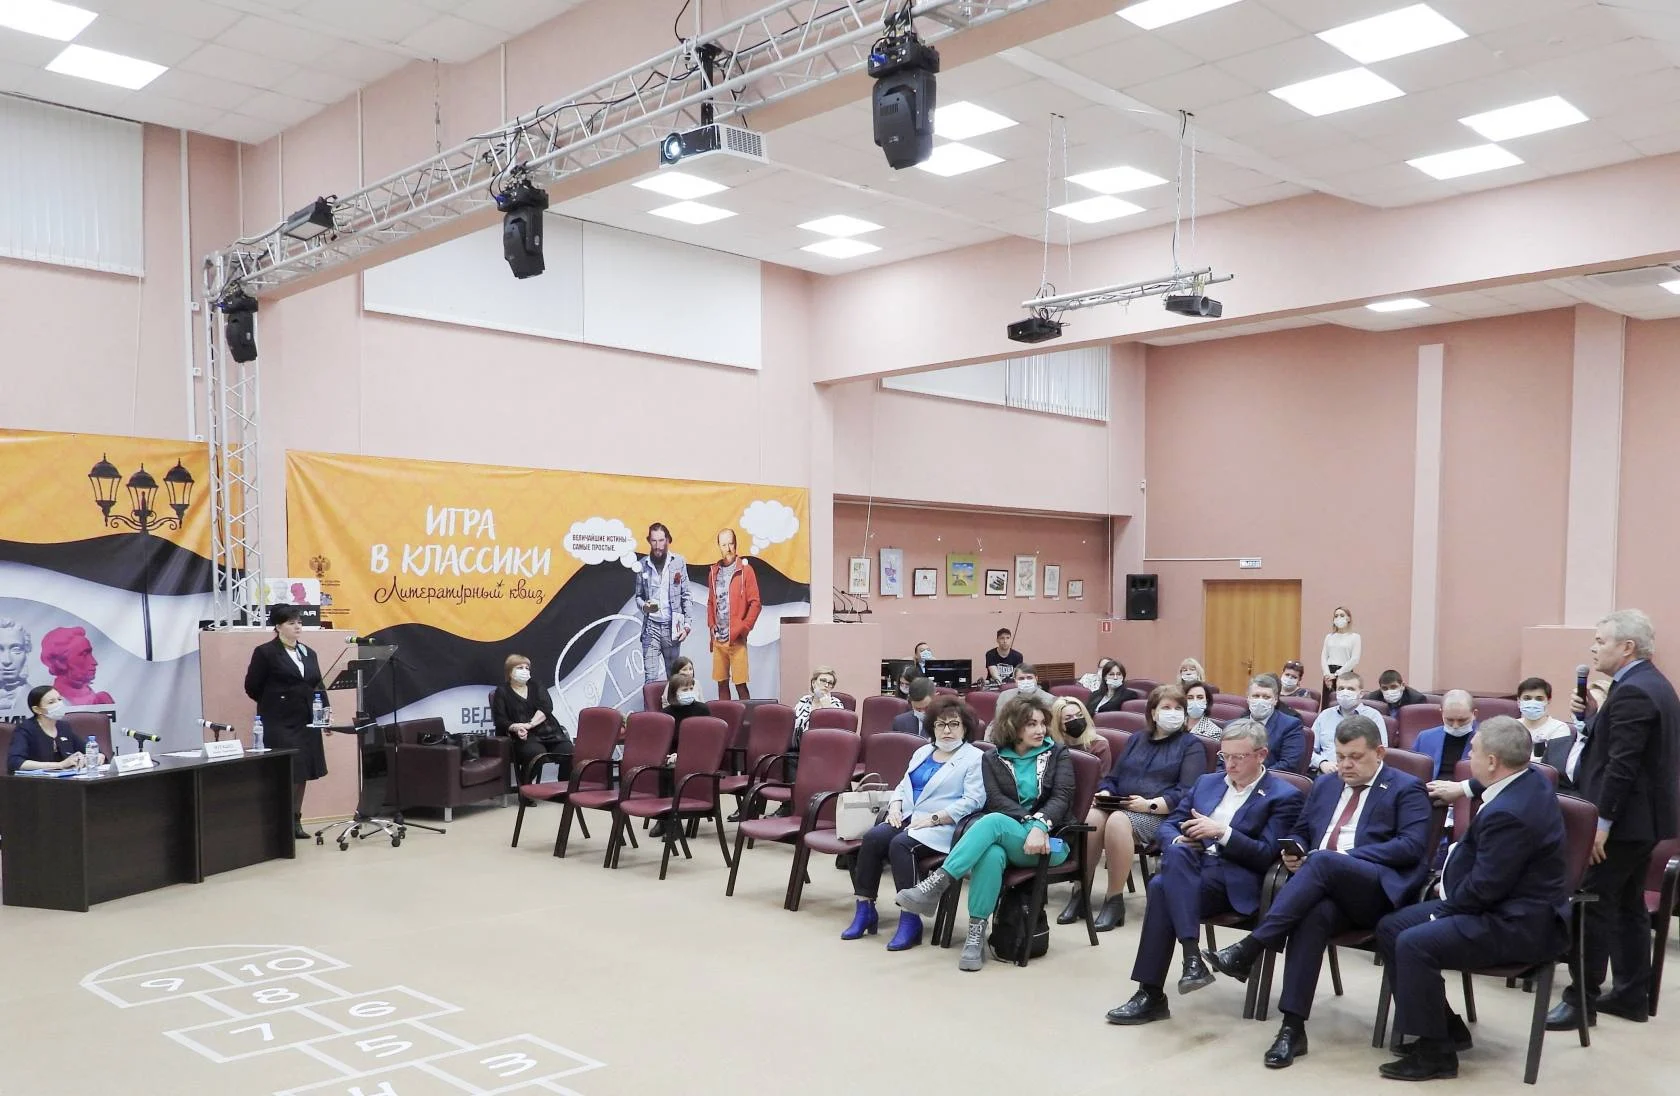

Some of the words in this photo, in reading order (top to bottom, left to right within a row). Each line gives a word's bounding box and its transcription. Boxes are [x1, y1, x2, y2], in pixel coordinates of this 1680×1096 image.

[425, 504, 496, 540] ИГРА
[572, 533, 605, 542] ВЕЛИЧАЙШИЕ
[606, 535, 627, 543] ИСТИНЫ
[572, 543, 591, 551] САМЫЕ
[370, 543, 390, 574] В
[401, 543, 551, 577] КЛАССИКИ
[374, 575, 504, 606] Литературный
[509, 578, 546, 604] квиз
[461, 706, 496, 728] ВЕД
[239, 957, 315, 977] 10
[140, 977, 185, 992] 9
[252, 987, 300, 1004] 8
[348, 1000, 397, 1018] 6
[228, 1022, 275, 1041] 7
[354, 1034, 413, 1058] 5
[478, 1052, 538, 1078] 3
